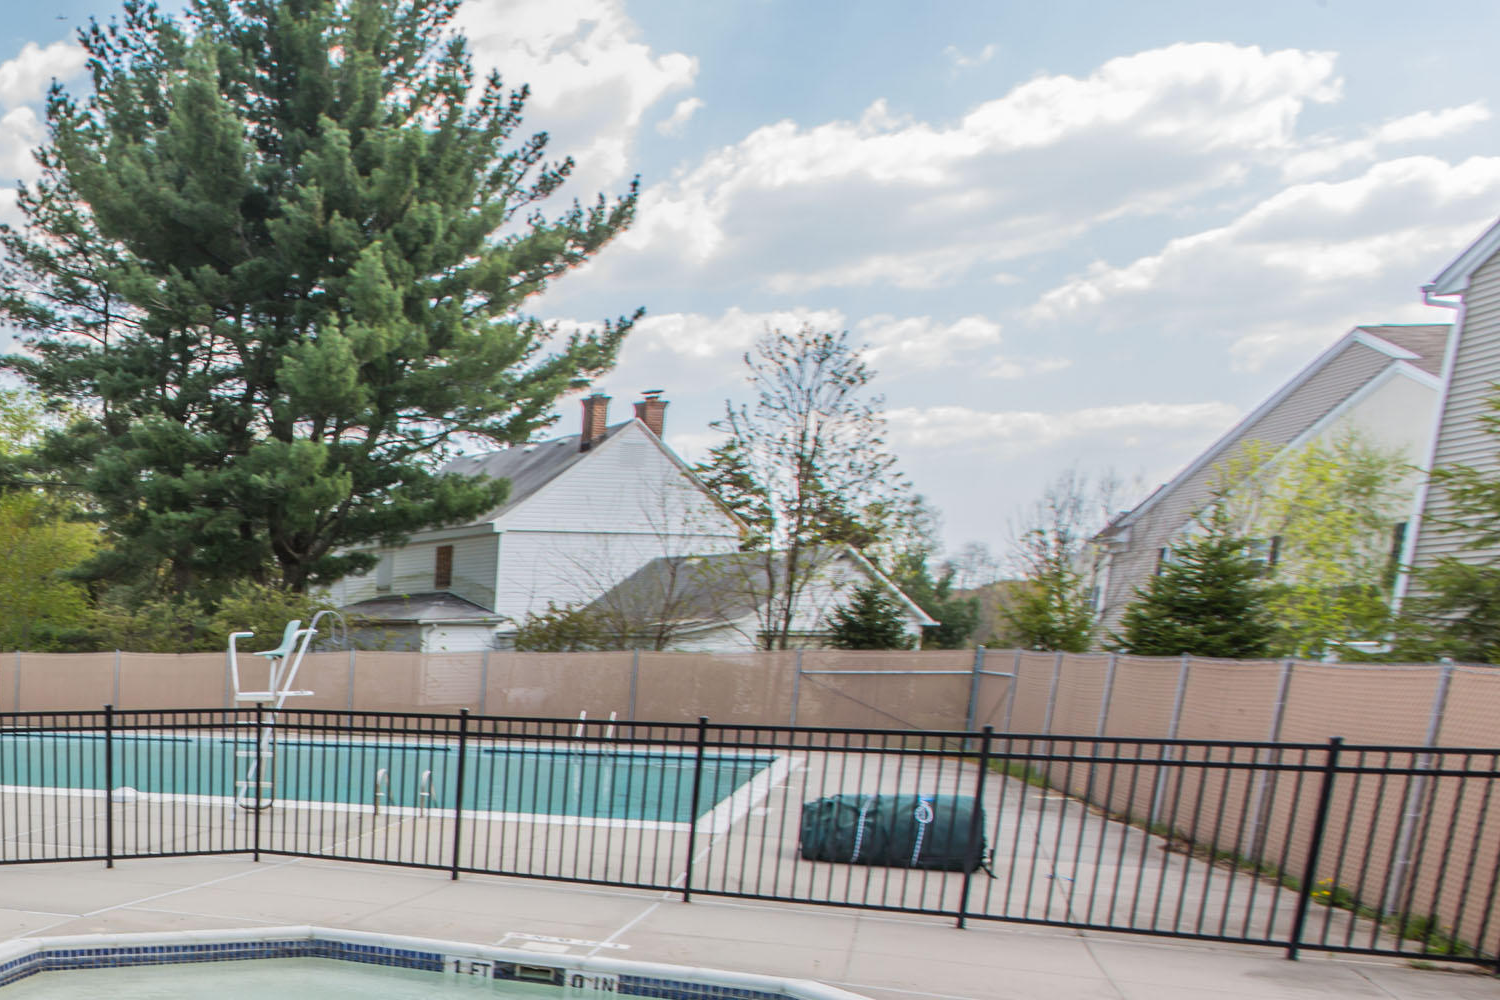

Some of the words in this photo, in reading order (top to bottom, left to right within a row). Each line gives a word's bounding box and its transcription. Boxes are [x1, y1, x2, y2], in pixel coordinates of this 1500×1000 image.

[453, 959, 462, 974] 1
[469, 962, 492, 978] FT
[594, 976, 615, 993] IN
